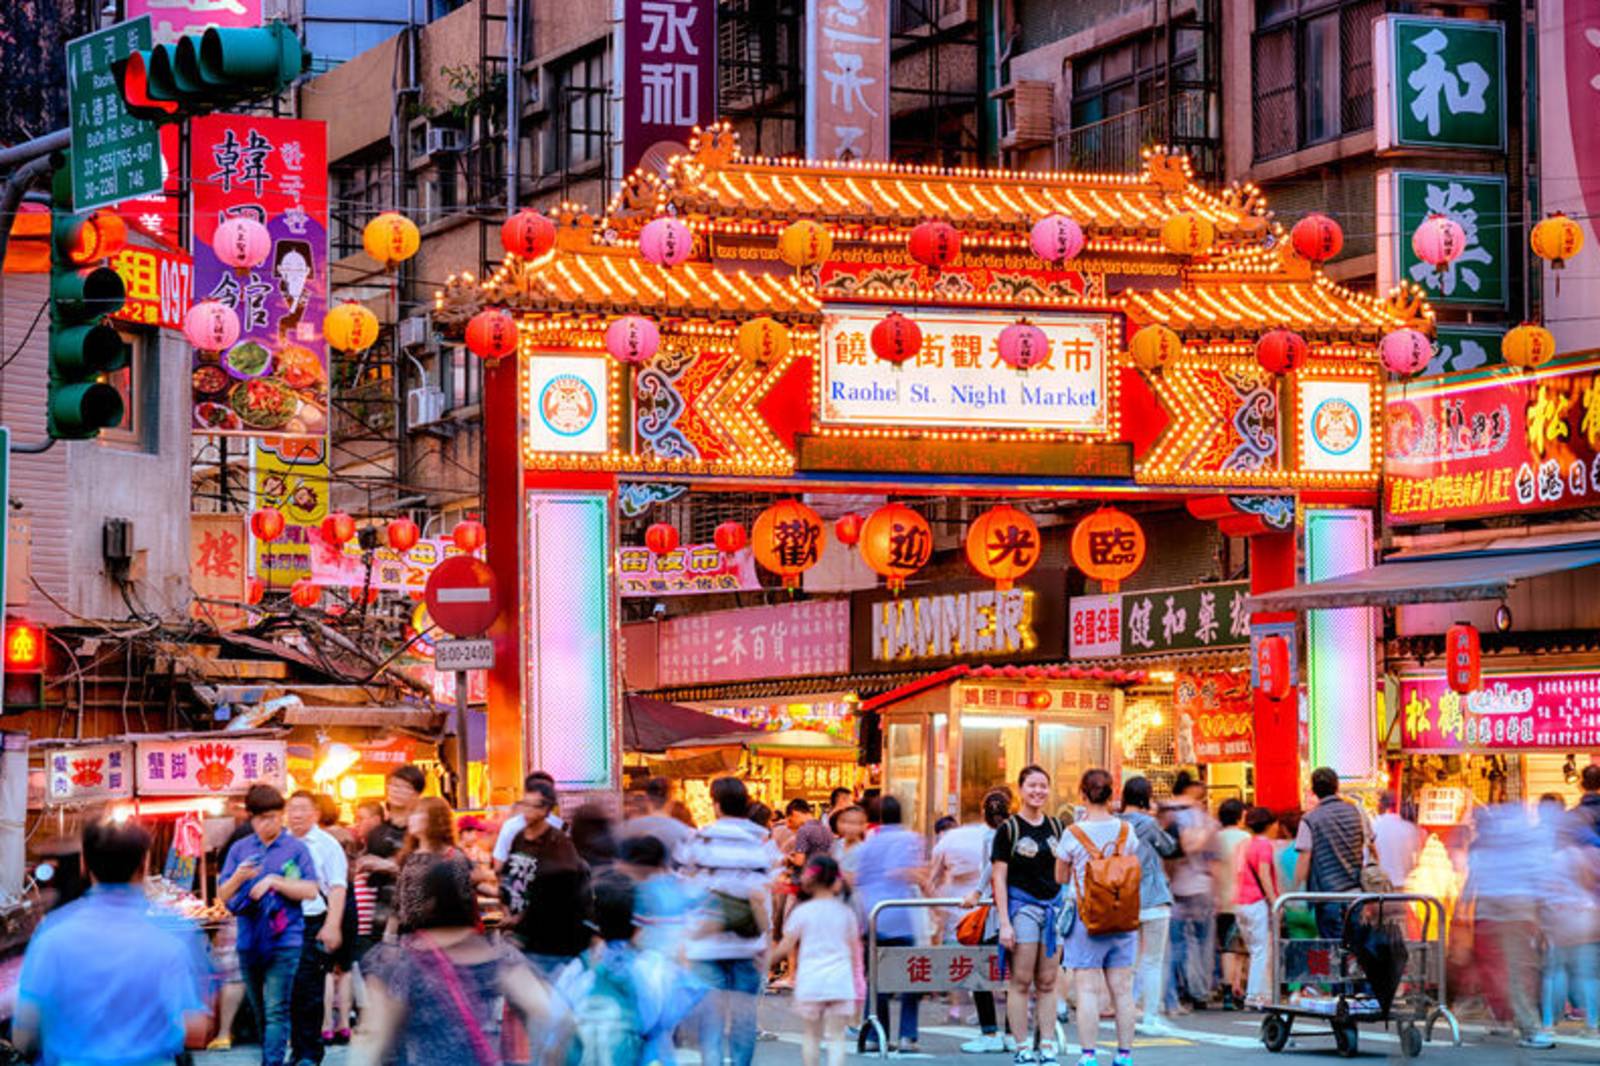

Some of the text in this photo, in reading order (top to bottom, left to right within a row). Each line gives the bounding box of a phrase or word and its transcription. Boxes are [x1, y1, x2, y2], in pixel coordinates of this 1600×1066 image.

[641, 0, 698, 126] 永和
[208, 128, 275, 333] 韓館
[834, 330, 1094, 374] 饒街觀市
[831, 380, 1097, 408] Raohe St. Night Market
[772, 518, 1137, 569] 歡 迎 光 臨
[712, 620, 789, 667] 三禾百貨
[872, 588, 1037, 661] HAMMER
